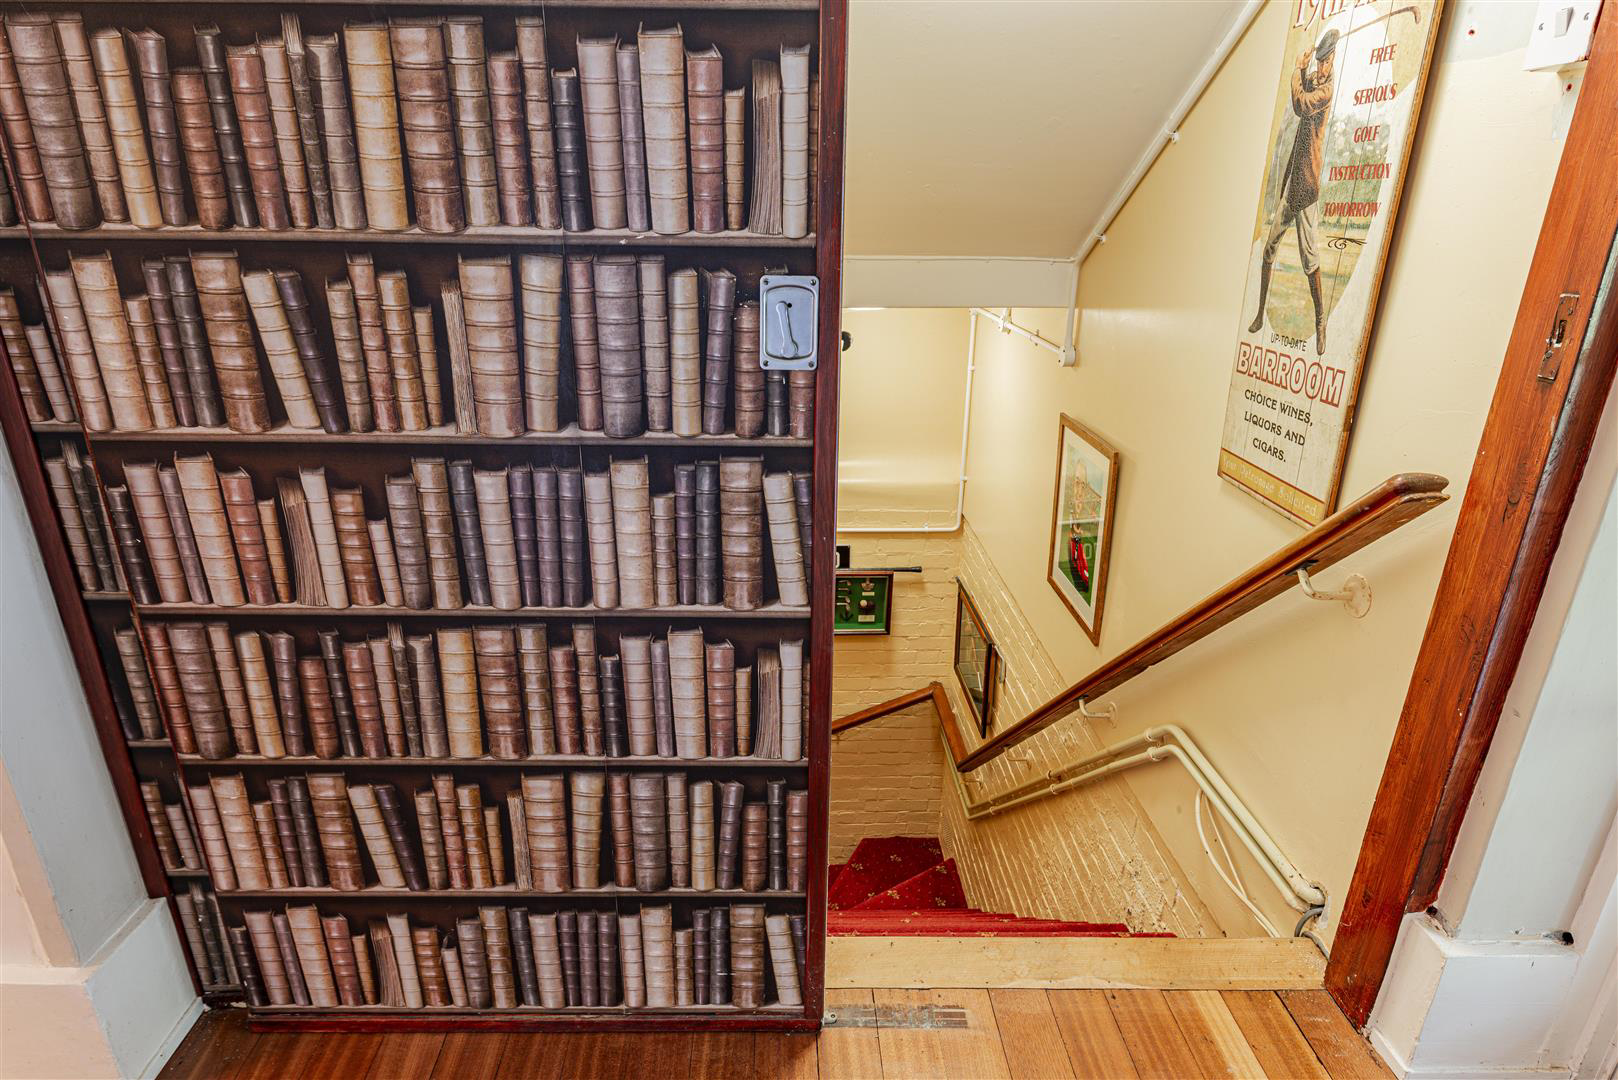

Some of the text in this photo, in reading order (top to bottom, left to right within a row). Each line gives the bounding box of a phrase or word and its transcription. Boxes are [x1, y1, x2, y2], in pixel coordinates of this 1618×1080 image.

[1369, 44, 1398, 65] FREE
[1352, 83, 1398, 106] SERIOUS
[1353, 125, 1380, 143] GOLF
[1328, 163, 1392, 181] INSTRUCTION
[1323, 202, 1381, 217] TOMORROW
[1236, 341, 1346, 408] BARROOM
[1244, 389, 1313, 427] CHOICE WINES,
[1244, 411, 1306, 446] LIQUORS AND
[1252, 437, 1286, 462] CIGARS.
